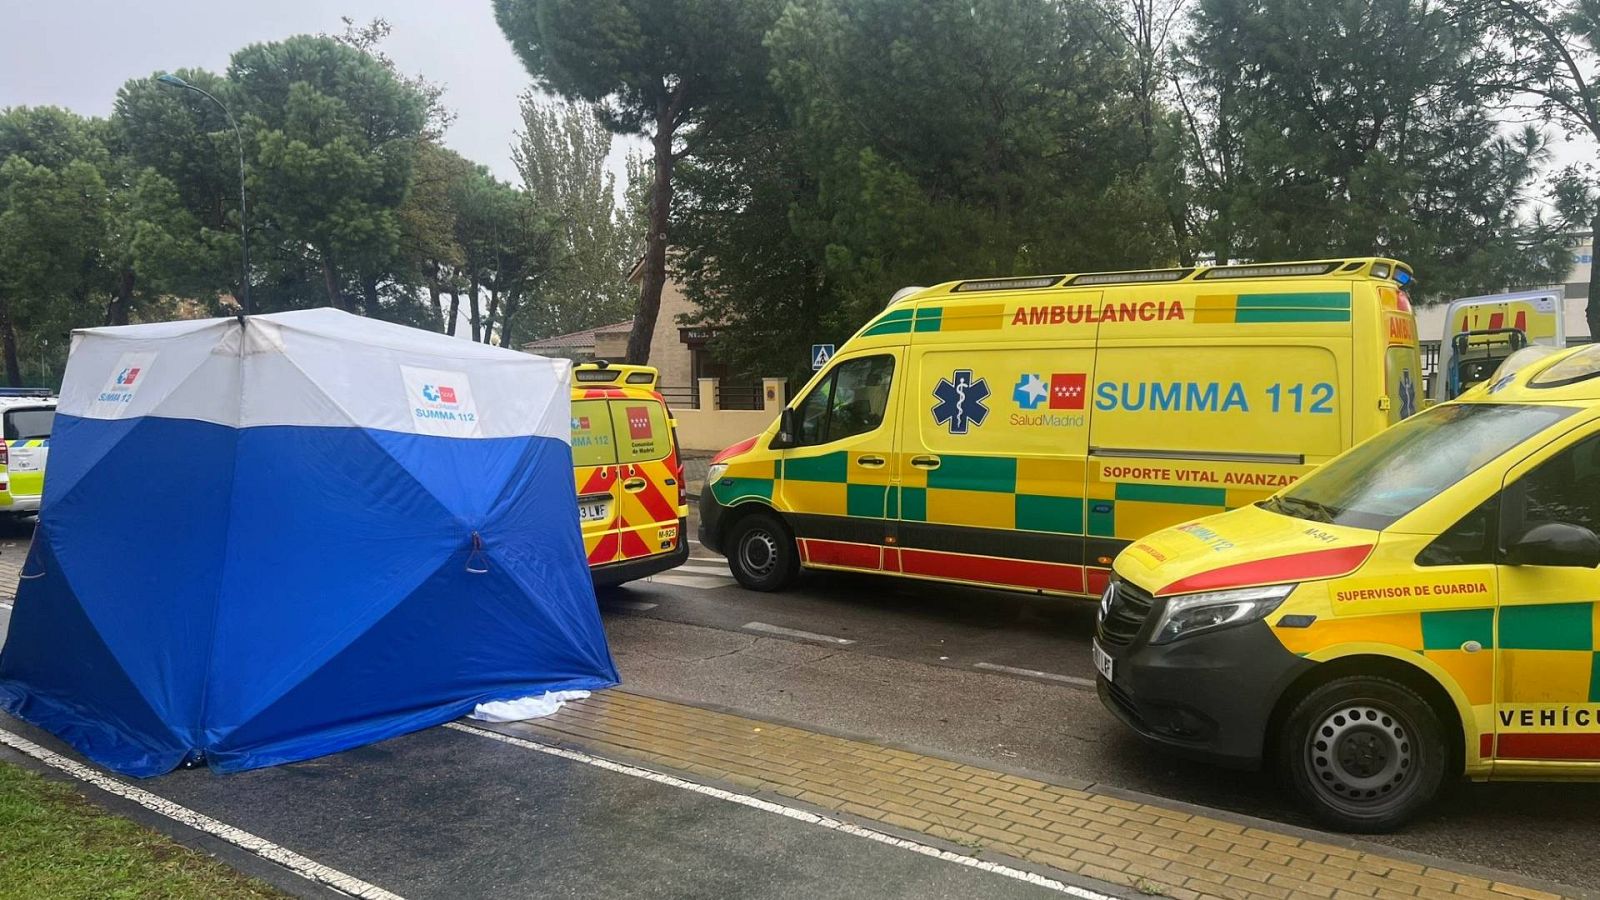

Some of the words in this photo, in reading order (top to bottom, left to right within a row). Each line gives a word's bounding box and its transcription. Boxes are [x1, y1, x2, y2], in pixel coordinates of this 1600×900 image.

[1011, 300, 1185, 326] AMBULANCIA
[1095, 382, 1249, 412] SUMMA
[1265, 382, 1334, 413] 112
[415, 408, 456, 420] SUMMA
[458, 413, 475, 421] 112
[1010, 413, 1084, 427] SaludMadrid
[594, 436, 609, 445] 112
[1103, 466, 1170, 480] SOPORTE
[1175, 470, 1219, 483] VITAL
[1303, 528, 1339, 543] M-941
[1336, 586, 1411, 602] SUPERVISOR
[1414, 586, 1430, 596] DE
[1433, 583, 1488, 595] GUARDIA
[1499, 706, 1600, 726] VEHÍC
